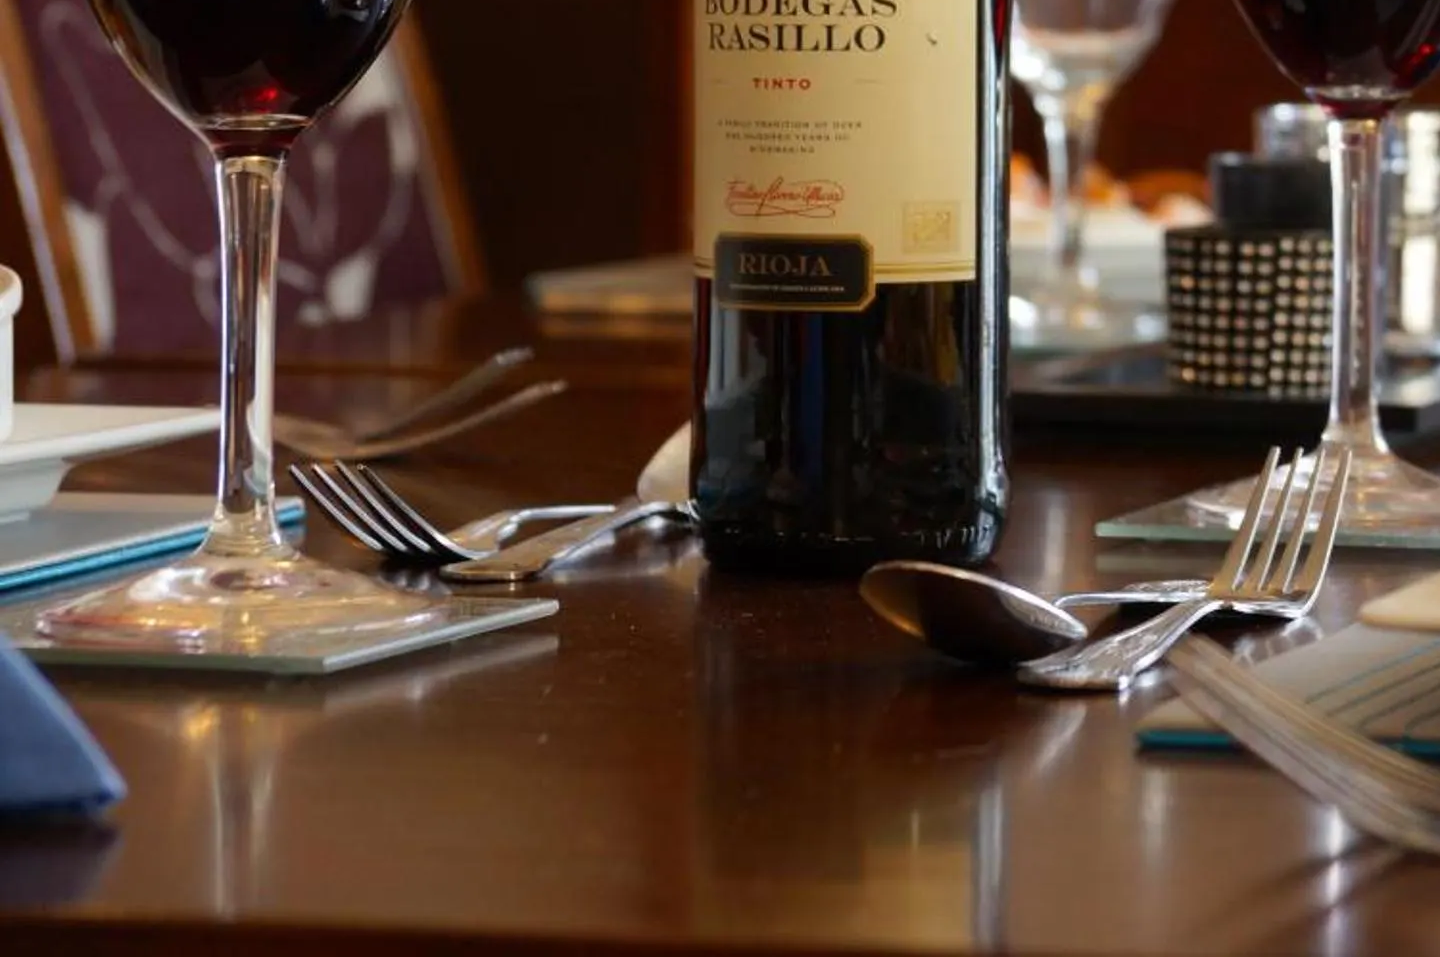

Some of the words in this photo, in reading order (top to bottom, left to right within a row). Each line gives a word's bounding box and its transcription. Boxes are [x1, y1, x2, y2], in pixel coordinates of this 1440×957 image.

[709, 22, 886, 52] RASILLO
[752, 77, 811, 90] TINTO
[738, 253, 832, 276] RIOJA
